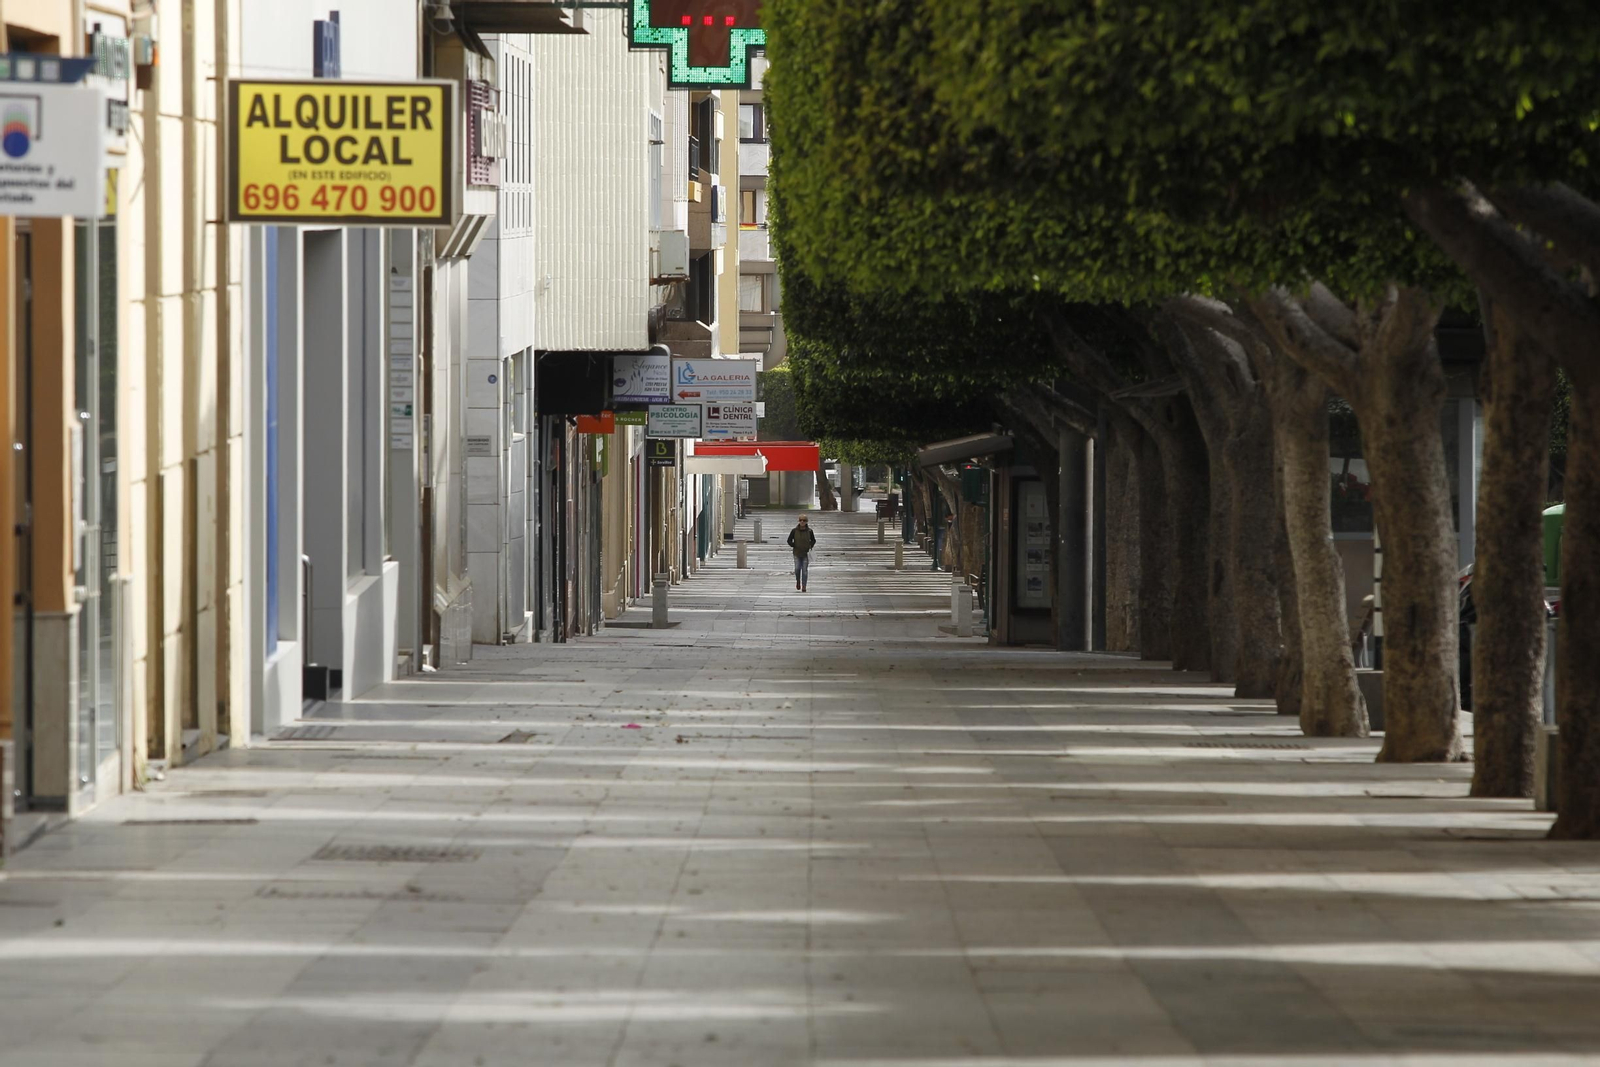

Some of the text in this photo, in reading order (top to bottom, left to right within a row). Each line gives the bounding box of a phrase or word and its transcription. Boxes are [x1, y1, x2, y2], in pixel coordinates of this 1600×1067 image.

[246, 94, 433, 131] ALQUILER
[280, 134, 413, 166] LOCAL
[288, 170, 392, 181] (EN ESTE EDIFICIO)
[243, 183, 436, 213] 696 470 900
[650, 411, 698, 419] PSICOLOGÍA
[723, 405, 753, 413] CLÍNICA
[656, 442, 667, 455] B
